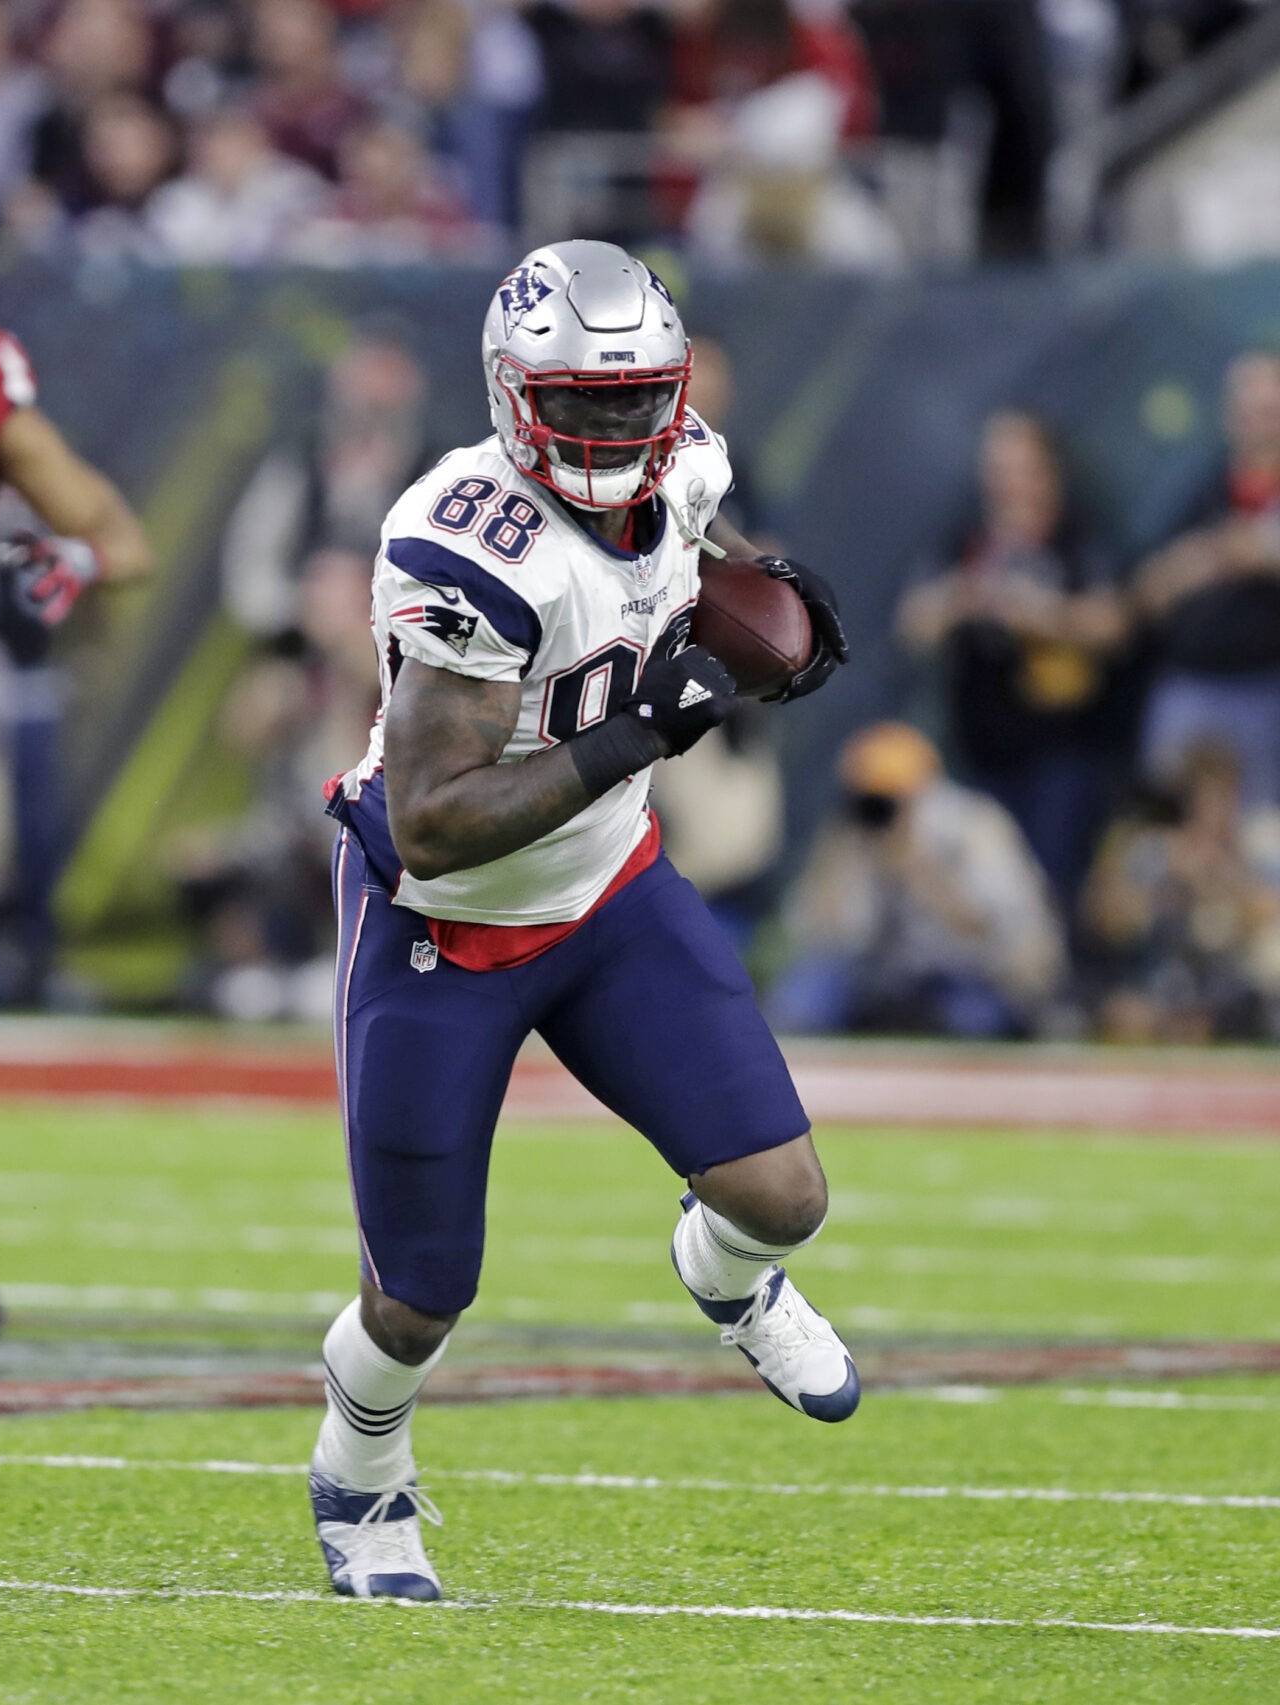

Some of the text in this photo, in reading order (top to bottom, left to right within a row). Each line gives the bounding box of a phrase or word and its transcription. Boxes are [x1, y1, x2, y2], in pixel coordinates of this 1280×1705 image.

[600, 351, 636, 365] PATRIOTS
[427, 474, 549, 565] 88
[620, 585, 668, 621] PATRIOTS
[678, 690, 713, 710] adidas
